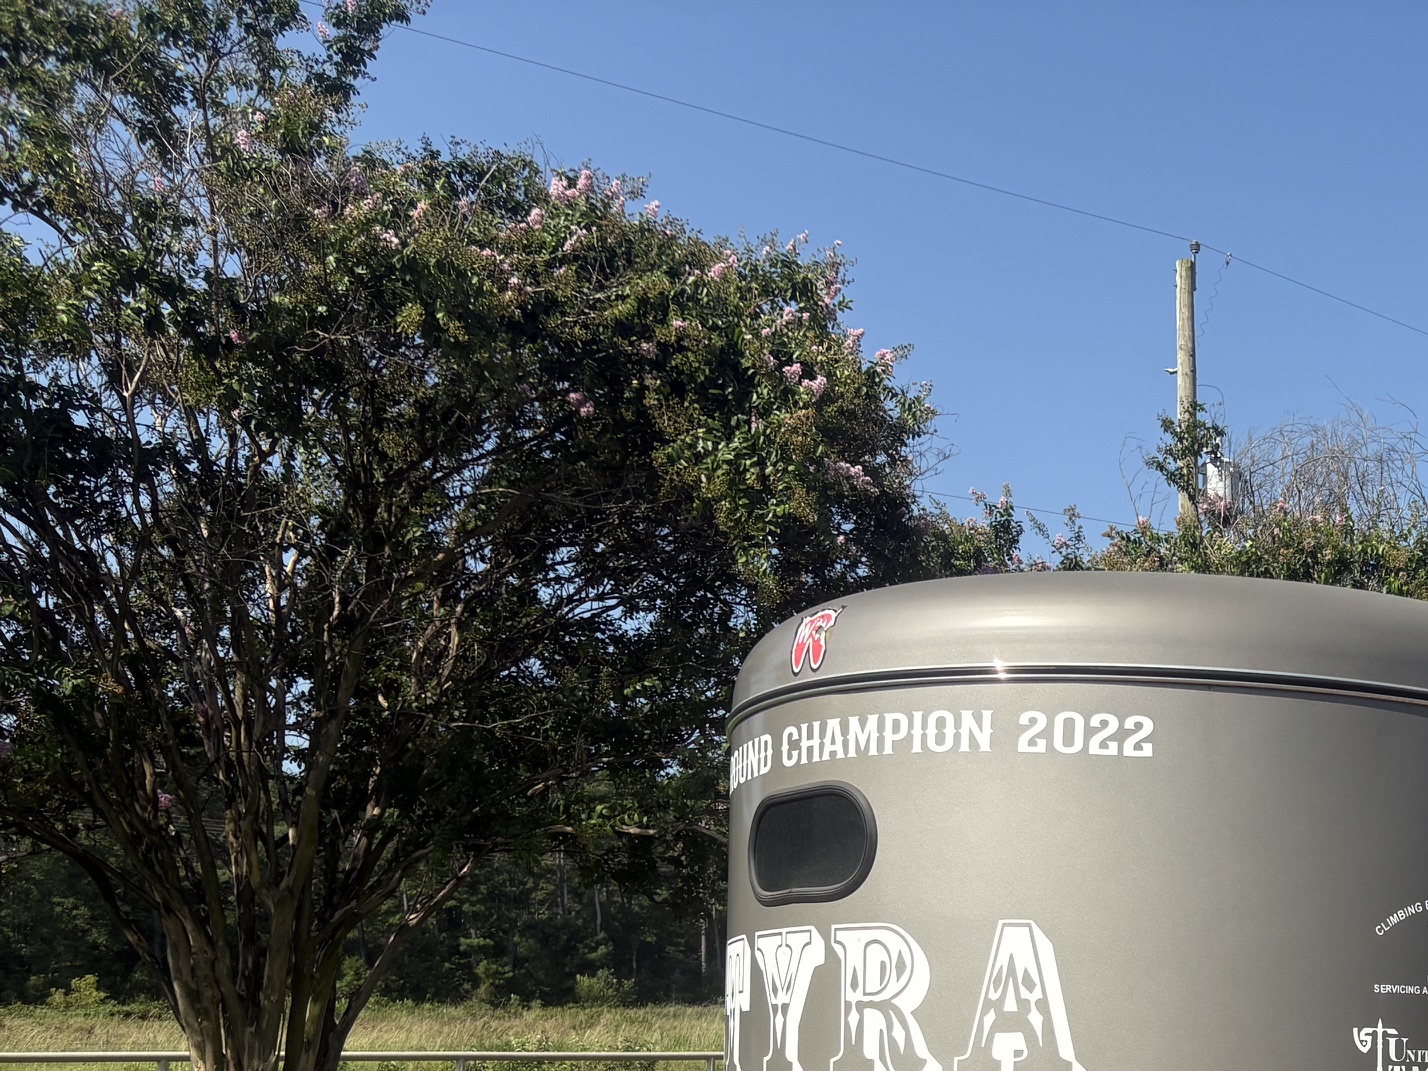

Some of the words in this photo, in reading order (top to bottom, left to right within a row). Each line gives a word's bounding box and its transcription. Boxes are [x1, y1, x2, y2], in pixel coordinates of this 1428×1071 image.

[781, 709, 994, 767] CHAMPION
[1017, 710, 1155, 758] 2022
[1375, 902, 1423, 936] CLIMBING
[1373, 984, 1421, 995] SERVICING
